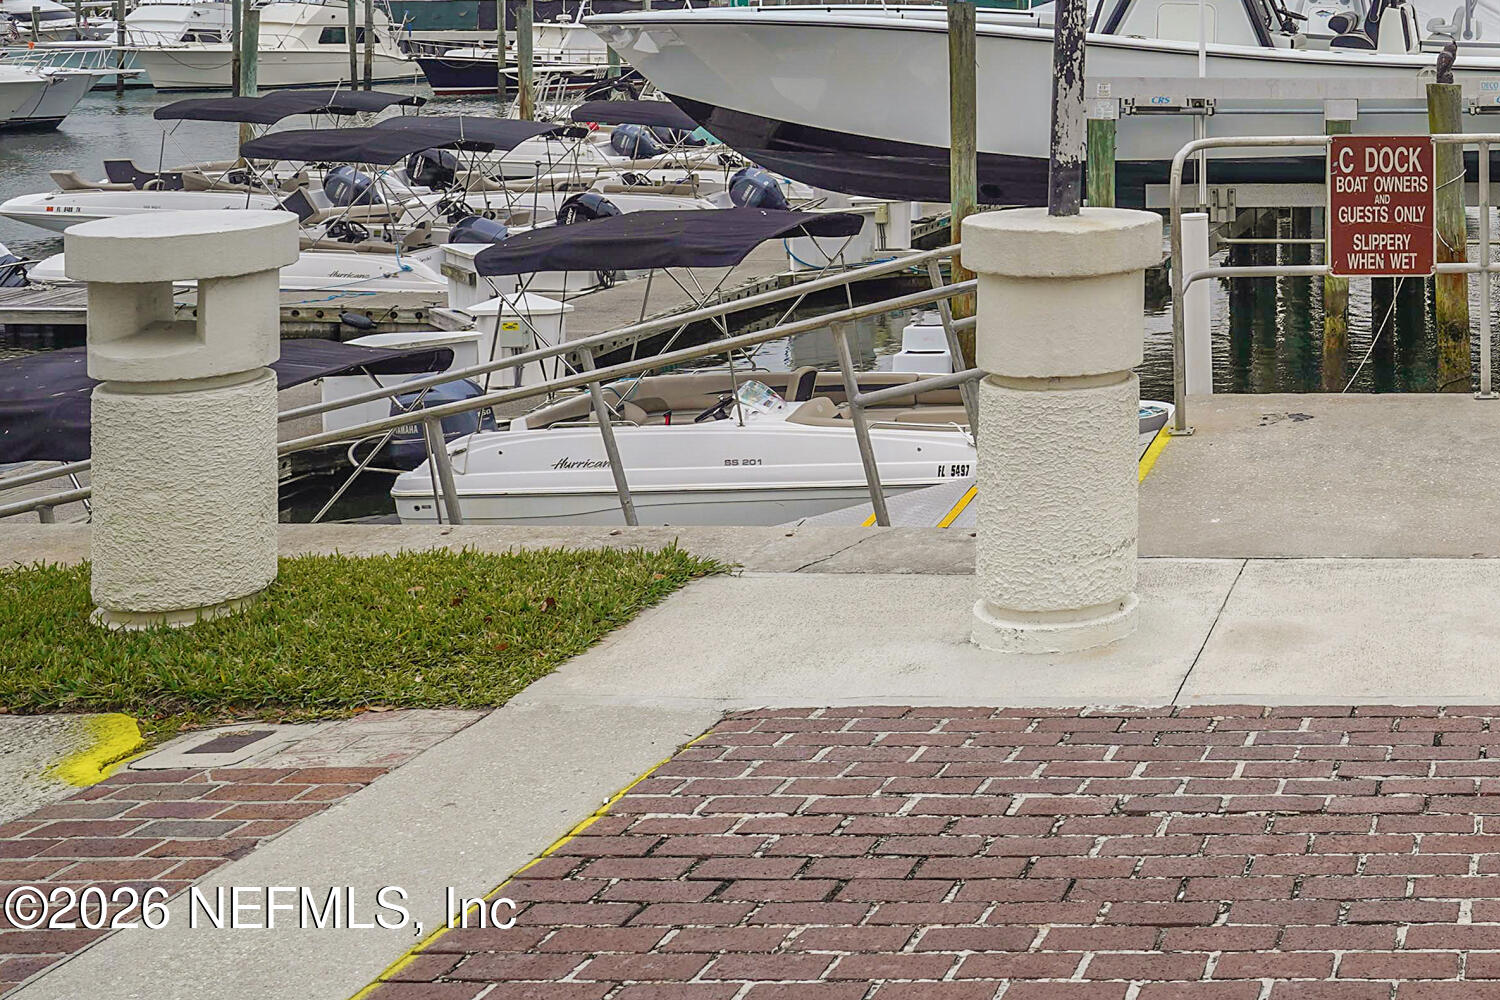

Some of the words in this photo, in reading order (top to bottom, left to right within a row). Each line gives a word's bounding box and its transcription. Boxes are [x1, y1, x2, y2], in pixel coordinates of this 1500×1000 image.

[1151, 96, 1171, 104] CRS
[1339, 146, 1354, 174] C
[1365, 146, 1423, 174] DOCK
[1336, 176, 1368, 193] BOAT
[1373, 175, 1428, 193] OWNERS
[1374, 194, 1391, 204] AND
[1338, 206, 1389, 223] GUESTS
[1394, 205, 1426, 223] ONLY
[1353, 233, 1411, 251] SLIPPERY
[1347, 253, 1385, 270] WHEN
[1390, 253, 1418, 269] WET
[395, 424, 419, 434] AMAHA
[551, 457, 612, 470] Hurrican
[724, 459, 739, 467] SS
[742, 458, 763, 466] 201
[937, 465, 946, 478] FL
[950, 464, 970, 477] 5497
